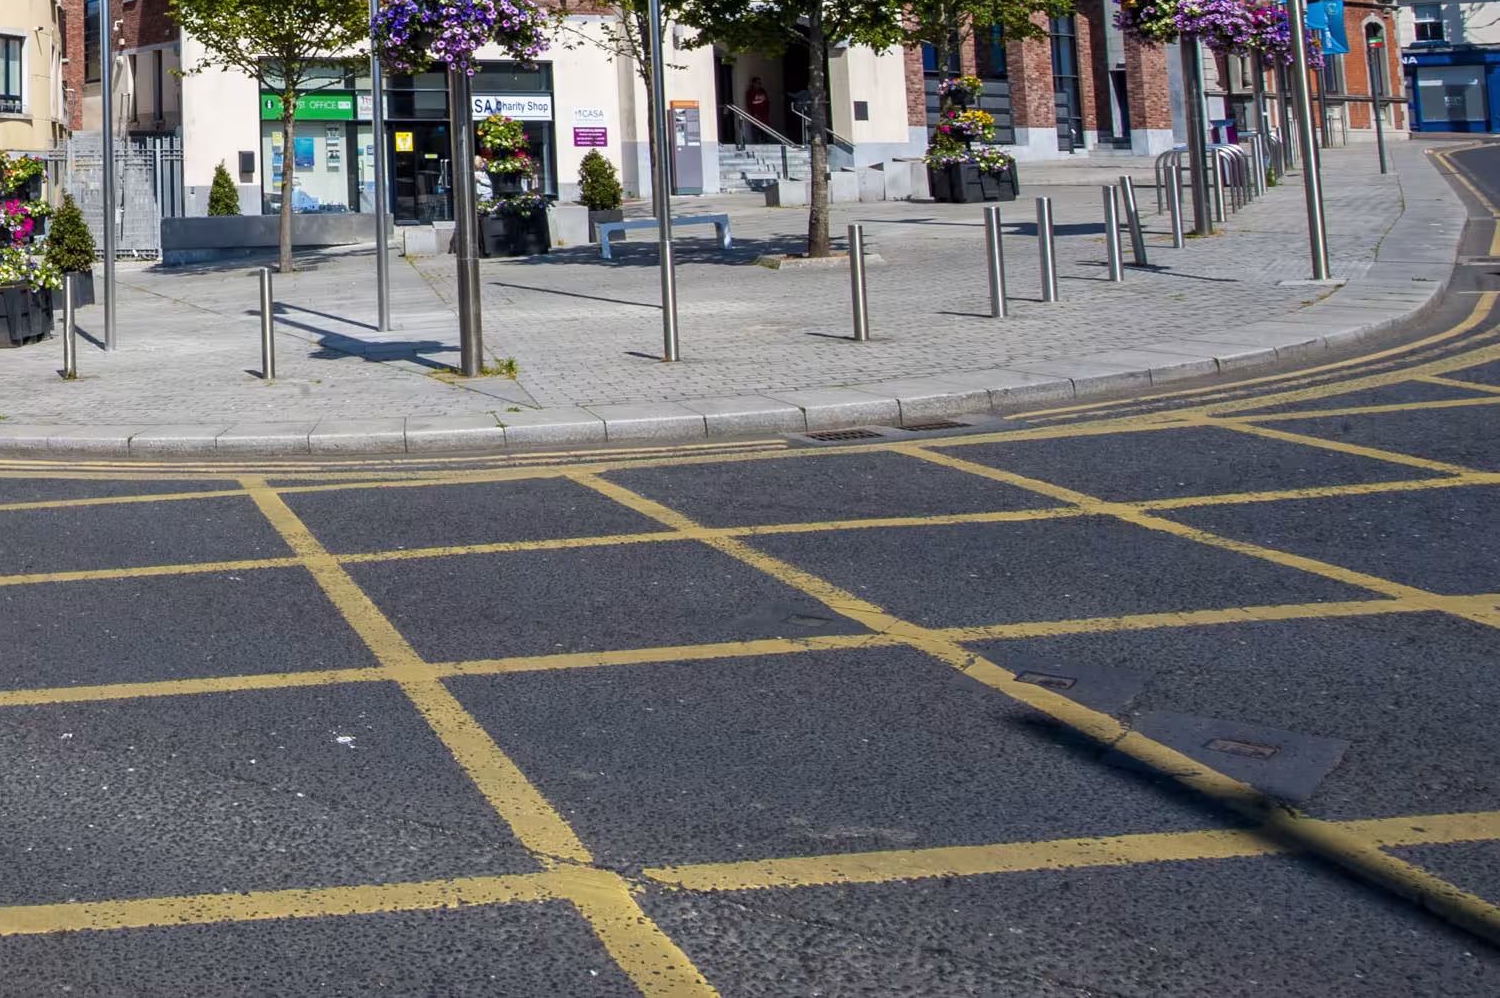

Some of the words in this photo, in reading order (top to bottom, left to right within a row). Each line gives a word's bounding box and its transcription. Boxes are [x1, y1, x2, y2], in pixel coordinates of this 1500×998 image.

[308, 100, 337, 110] OFFICE
[527, 101, 549, 113] Shop
[582, 109, 604, 118] CASA
